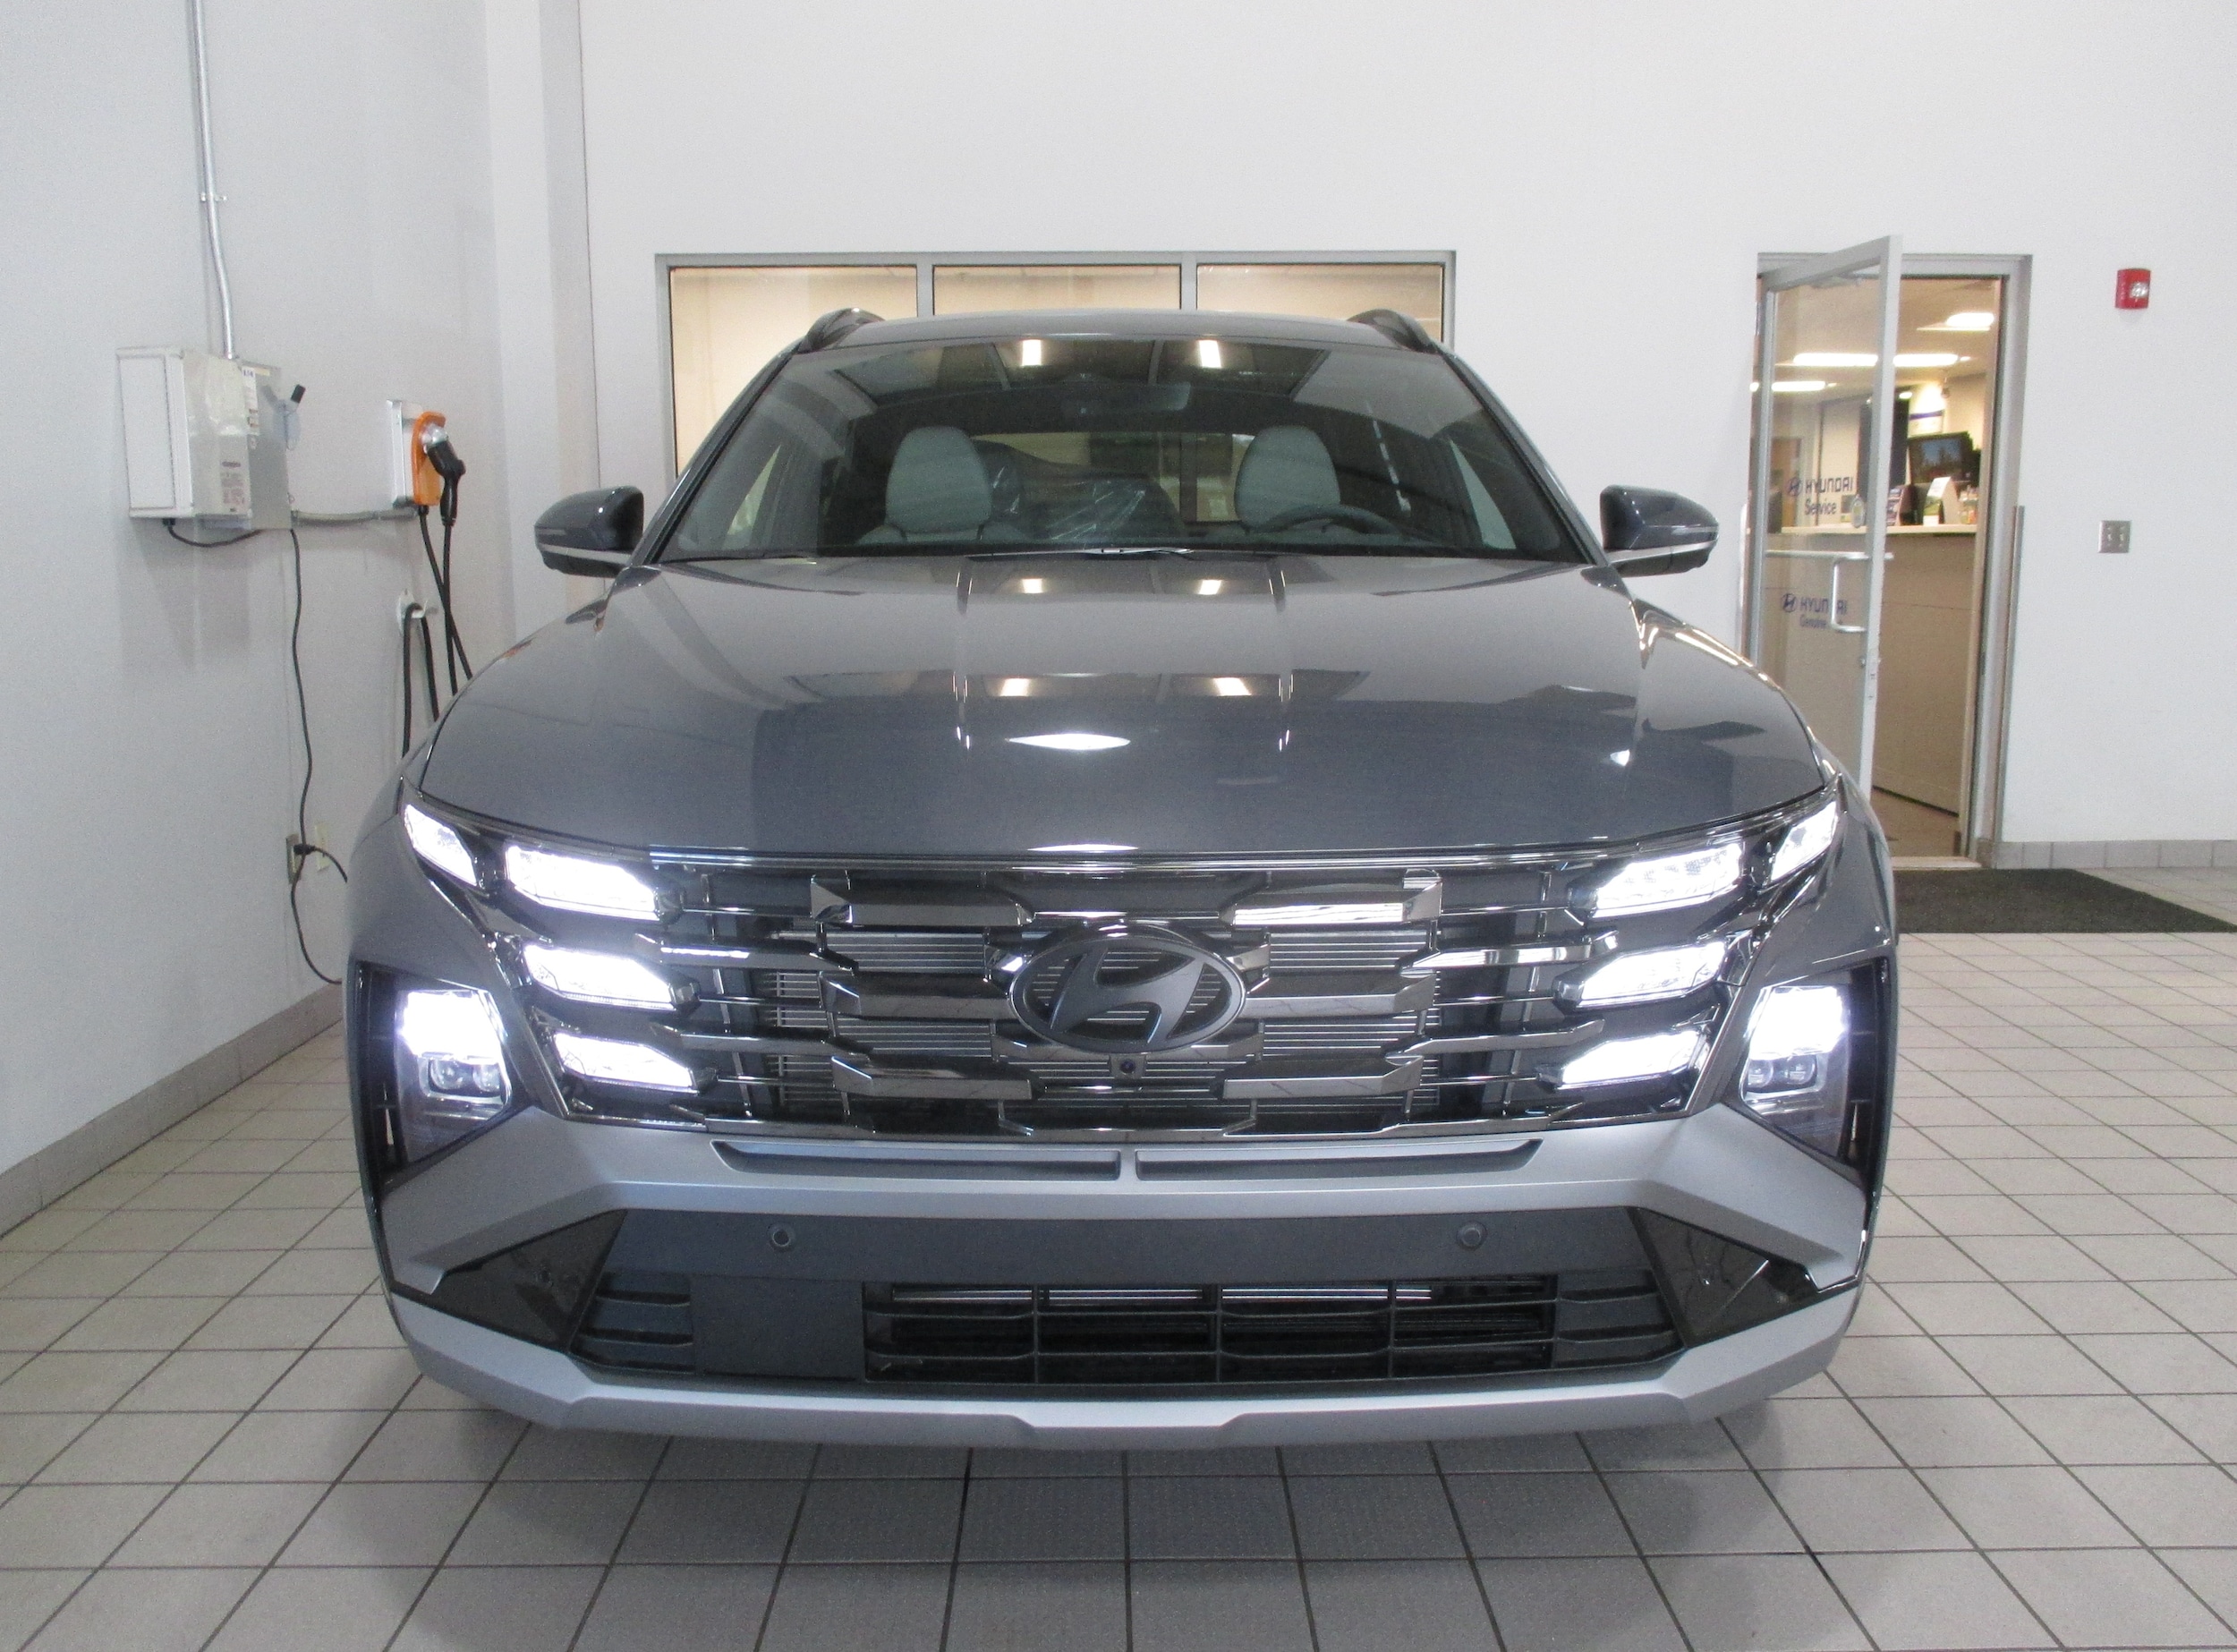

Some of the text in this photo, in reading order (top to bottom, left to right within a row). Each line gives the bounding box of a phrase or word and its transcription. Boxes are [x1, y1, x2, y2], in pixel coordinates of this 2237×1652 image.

[1805, 477, 1853, 494] HYUNDAI
[1804, 498, 1837, 515] Service
[1799, 597, 1848, 615] HYUNAI
